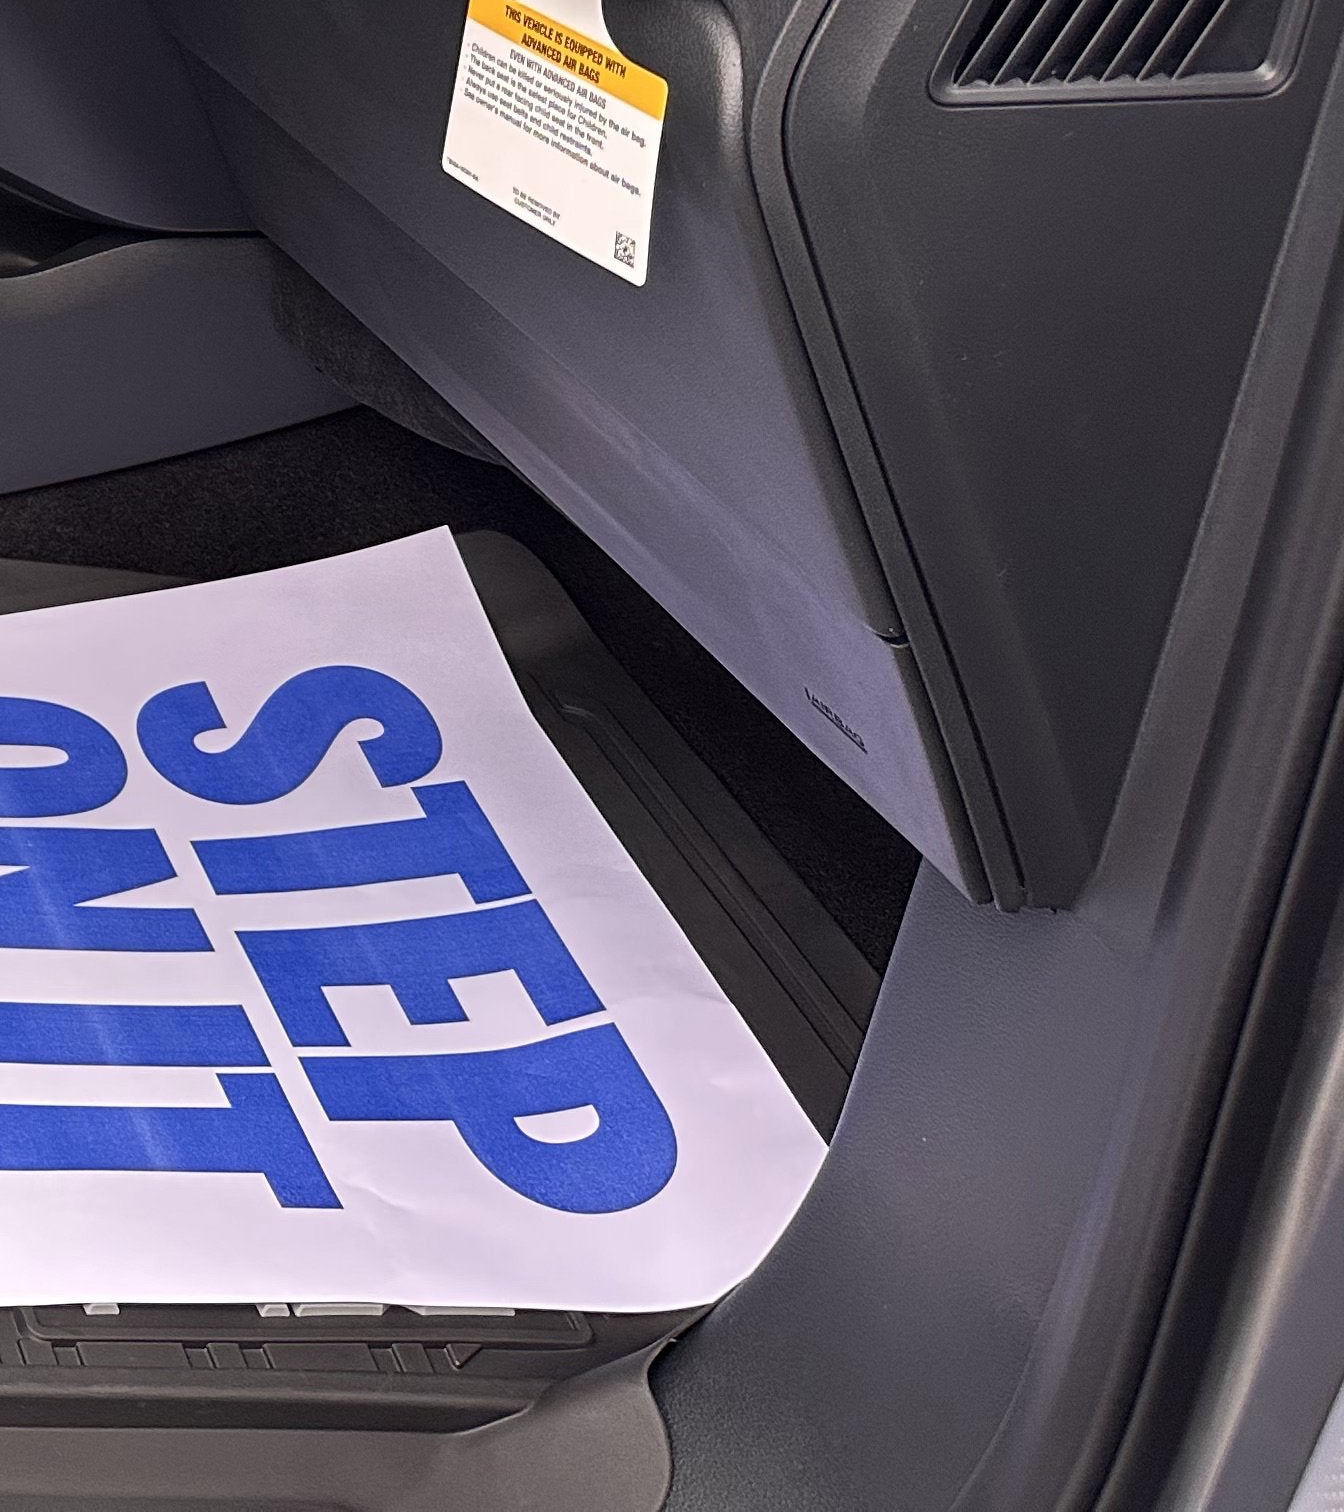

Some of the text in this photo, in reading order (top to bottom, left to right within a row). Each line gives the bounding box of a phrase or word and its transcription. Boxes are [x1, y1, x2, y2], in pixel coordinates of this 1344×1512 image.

[505, 5, 627, 79] THIS VEHICLE IS EQUIPPED WITH
[521, 32, 600, 84] ADVANCED AIR BAGS
[472, 42, 496, 63] Children
[573, 99, 597, 120] injured
[598, 113, 607, 126] by
[608, 119, 619, 132] the
[620, 125, 630, 138] air
[631, 130, 647, 149] bag.
[510, 48, 607, 109] EVEN WITH ADVANCED AIR BAGS
[574, 126, 585, 139] the
[589, 161, 610, 178] about
[610, 173, 621, 185] air
[136, 664, 679, 1216] STEP
